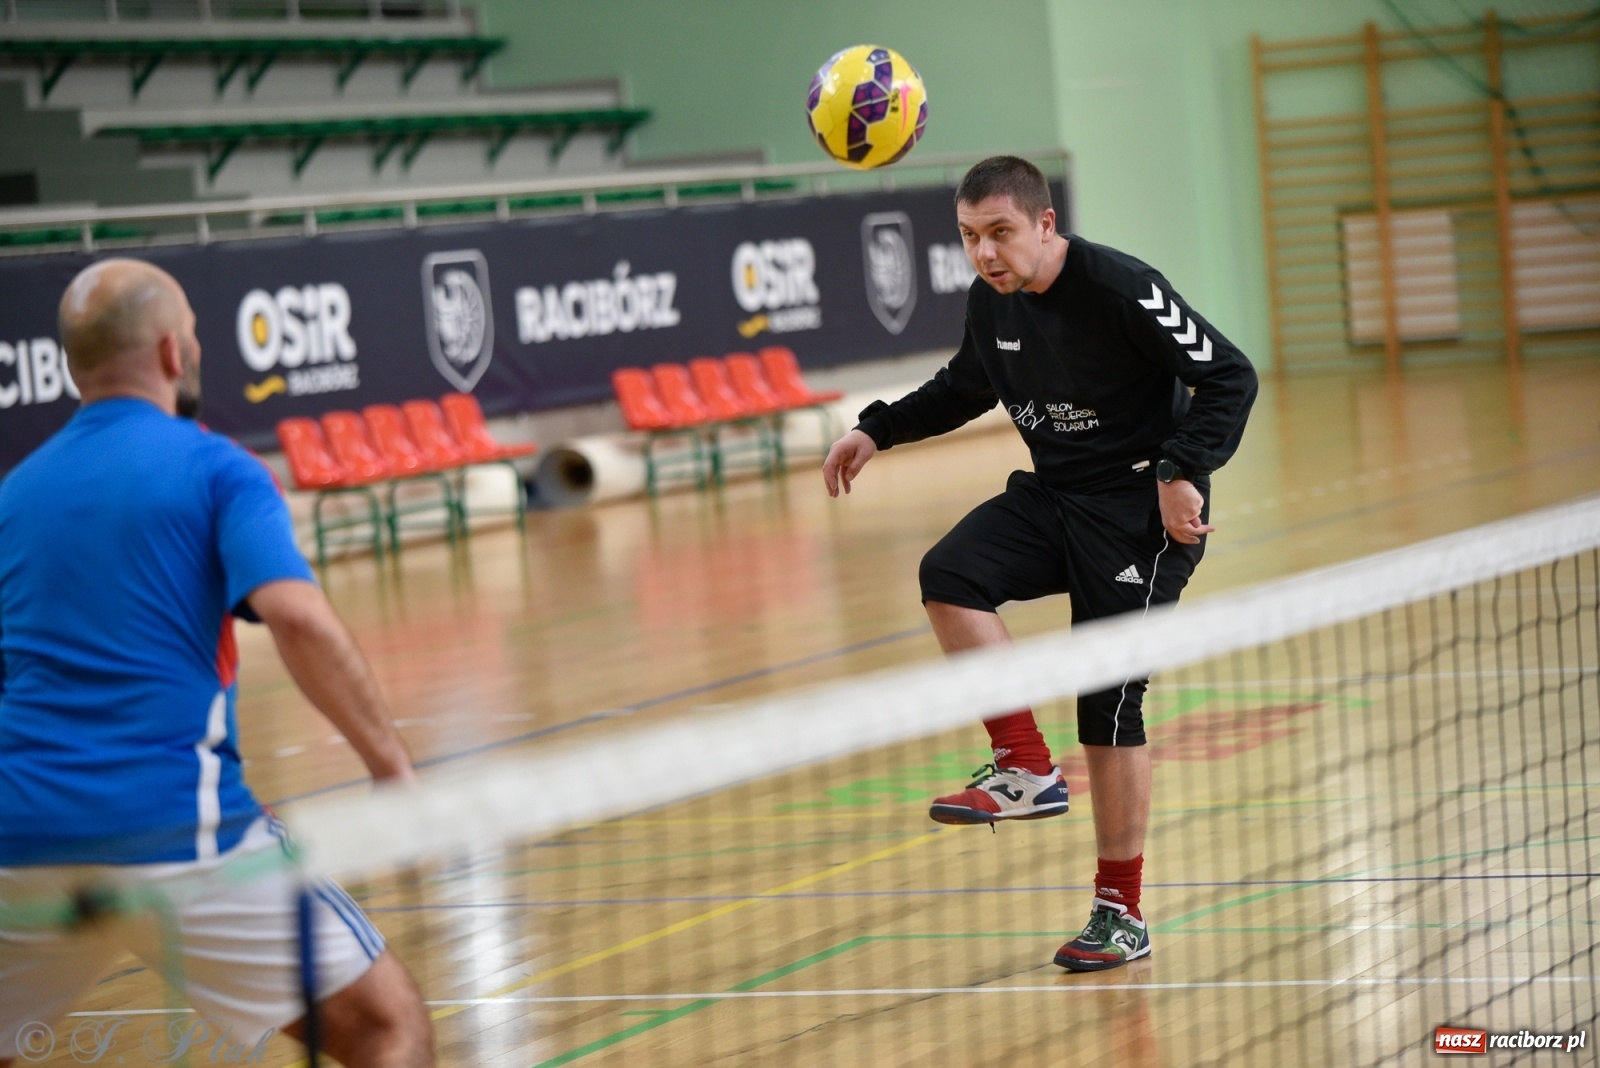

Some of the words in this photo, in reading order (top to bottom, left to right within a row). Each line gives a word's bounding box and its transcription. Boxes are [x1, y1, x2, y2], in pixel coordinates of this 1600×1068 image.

[514, 259, 681, 344] RACIBÓRZ
[996, 337, 1021, 351] hummel
[1045, 402, 1073, 412] SALON
[1053, 419, 1099, 432] SOLARIUM
[1115, 575, 1143, 584] adidas
